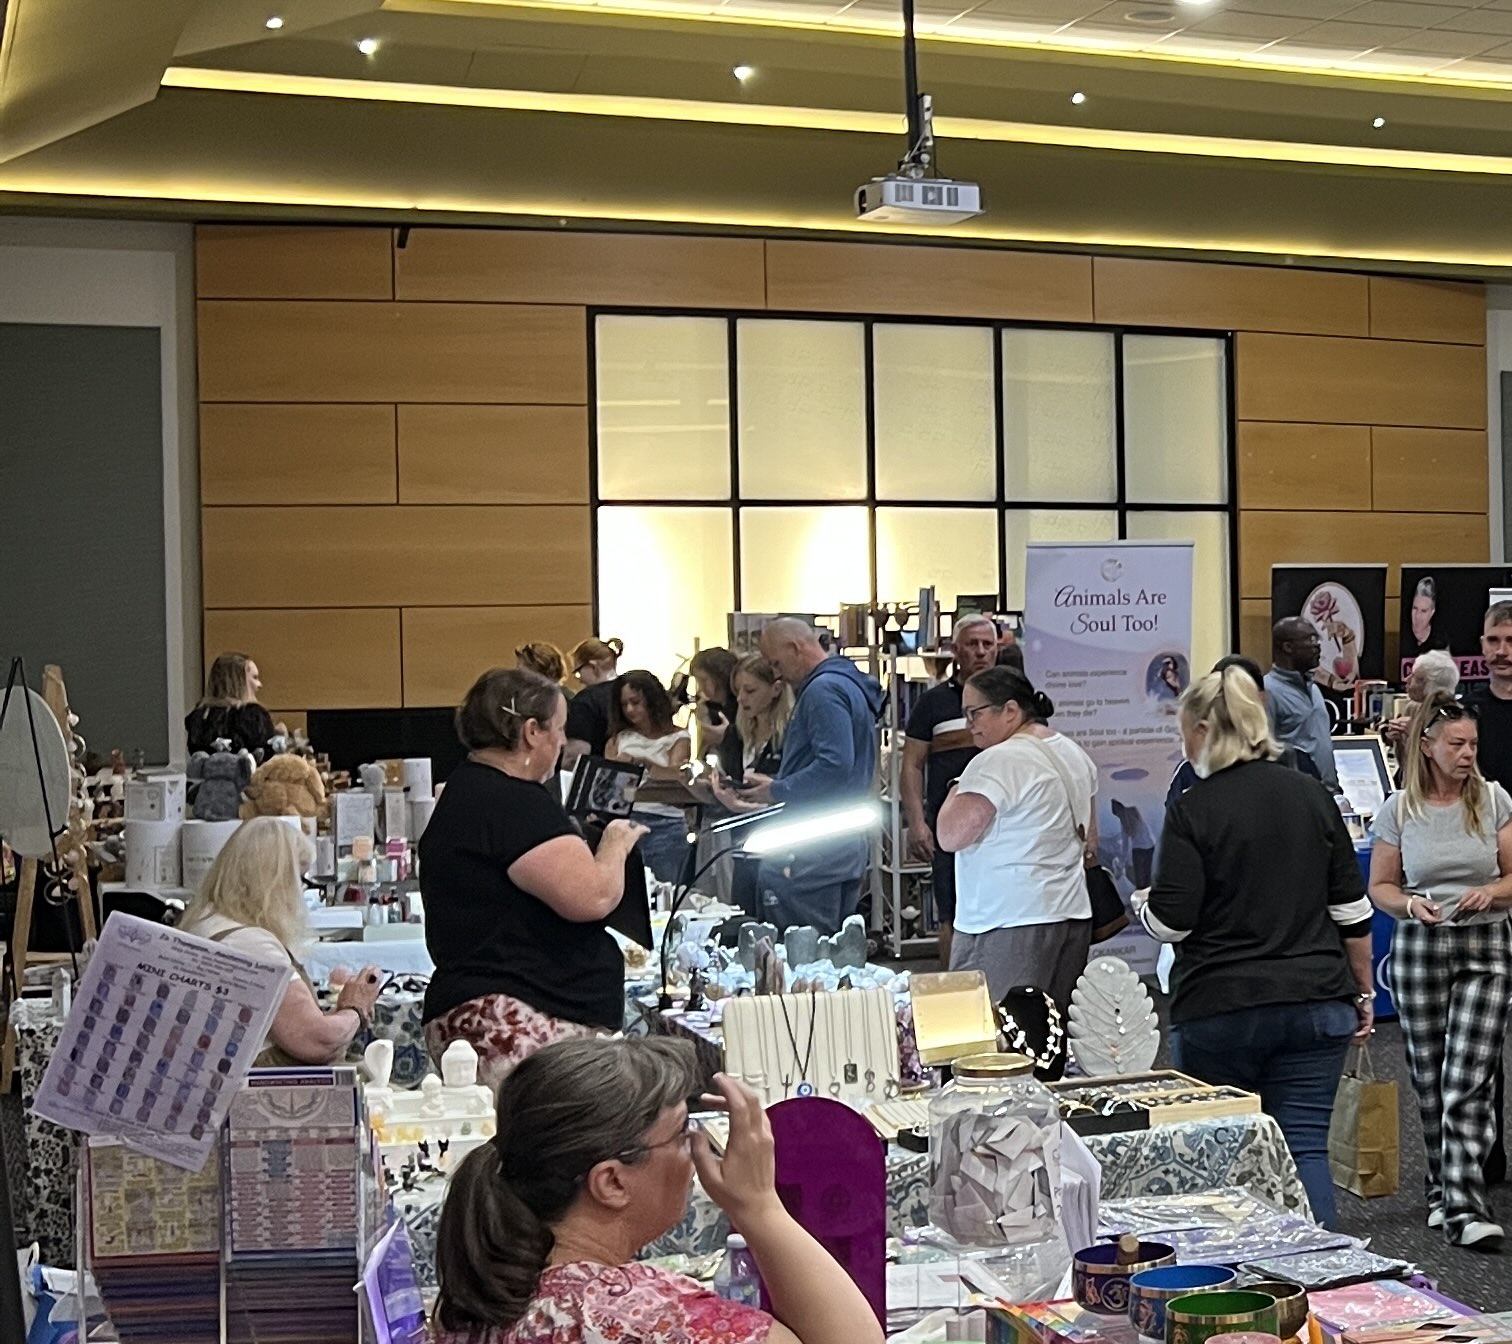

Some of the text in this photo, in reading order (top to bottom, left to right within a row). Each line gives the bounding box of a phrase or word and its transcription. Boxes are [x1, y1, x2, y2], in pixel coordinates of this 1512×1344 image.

[1054, 585, 1167, 607] Animals Are
[1070, 613, 1158, 635] Soul Too!
[136, 962, 166, 978] MINI
[169, 972, 211, 991] CHARTS
